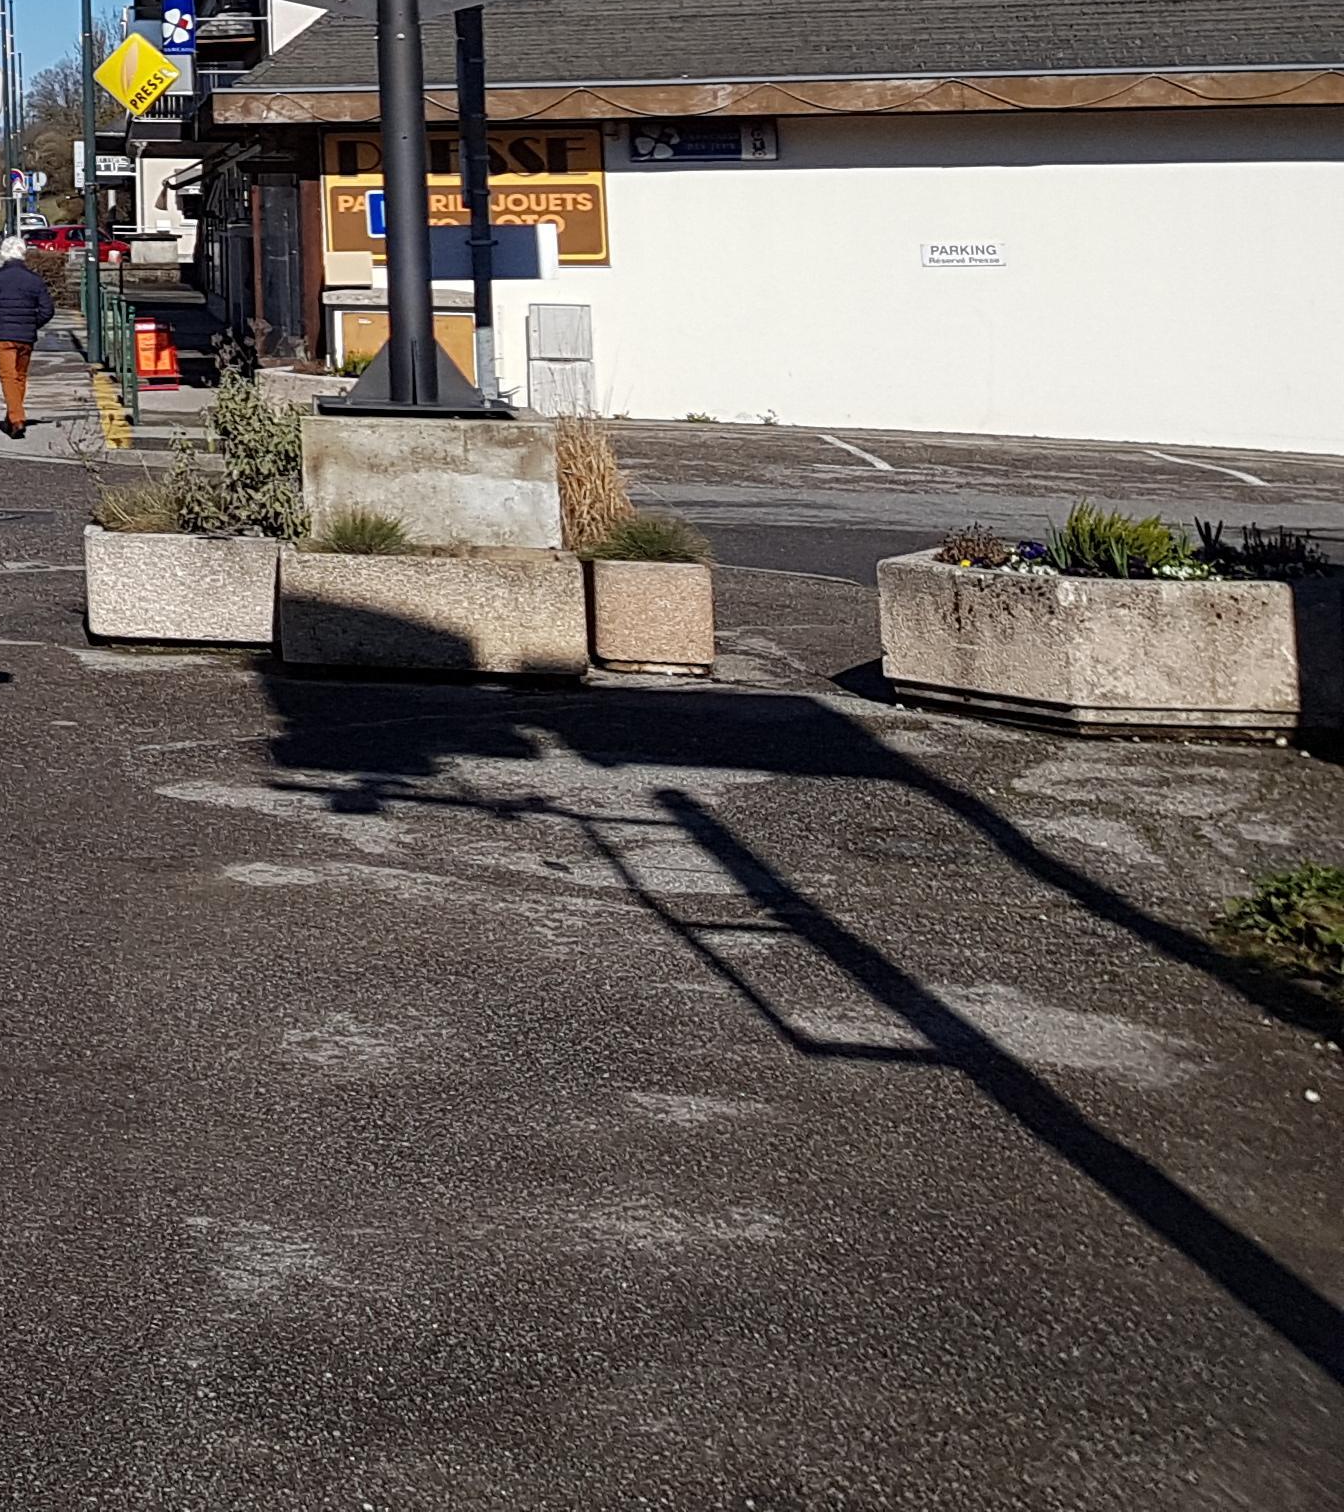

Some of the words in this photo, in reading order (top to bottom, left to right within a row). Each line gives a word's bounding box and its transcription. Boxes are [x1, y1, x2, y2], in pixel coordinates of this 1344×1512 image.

[337, 136, 590, 177] PESSE
[491, 193, 594, 212] JOUETS
[930, 244, 997, 256] PARKING
